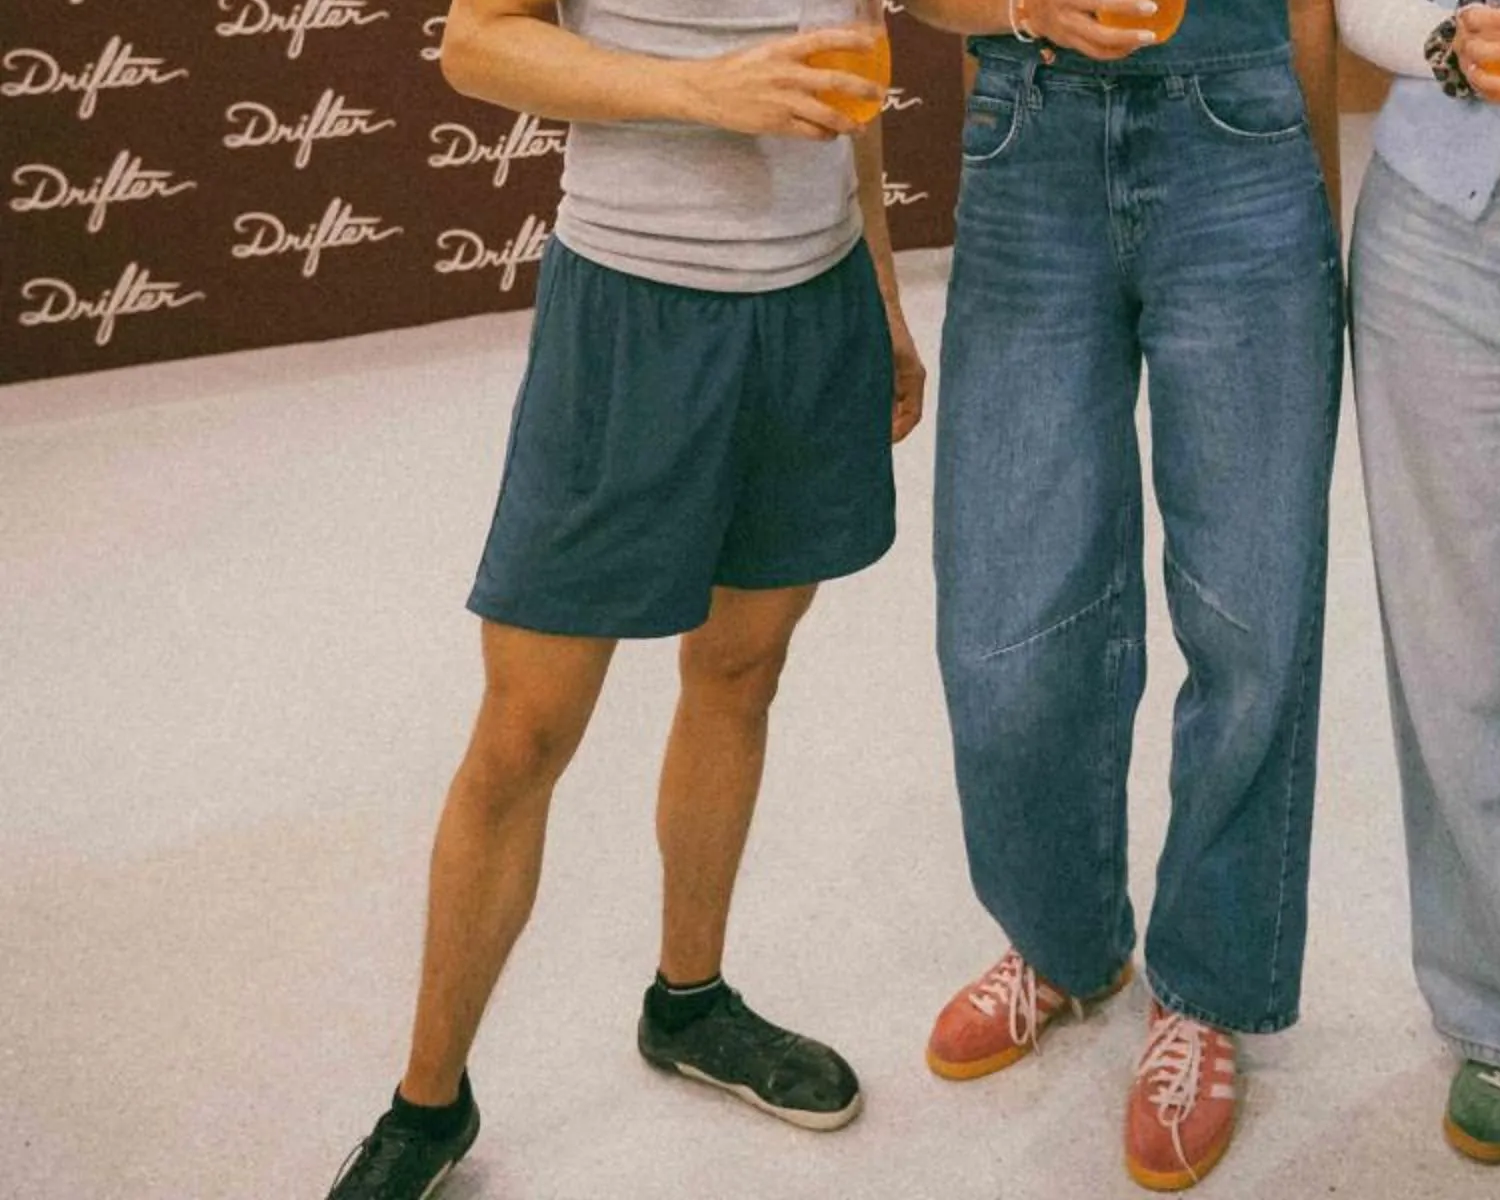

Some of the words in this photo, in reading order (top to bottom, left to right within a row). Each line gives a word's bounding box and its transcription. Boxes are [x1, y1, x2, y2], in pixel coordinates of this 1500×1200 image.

[1, 35, 188, 119] Drifter
[223, 88, 395, 169] Drifter
[427, 112, 566, 188] Drifter
[12, 150, 197, 233] Drifter
[232, 197, 403, 277] Drifter
[434, 215, 549, 291] Drift
[20, 262, 205, 345] Drifter
